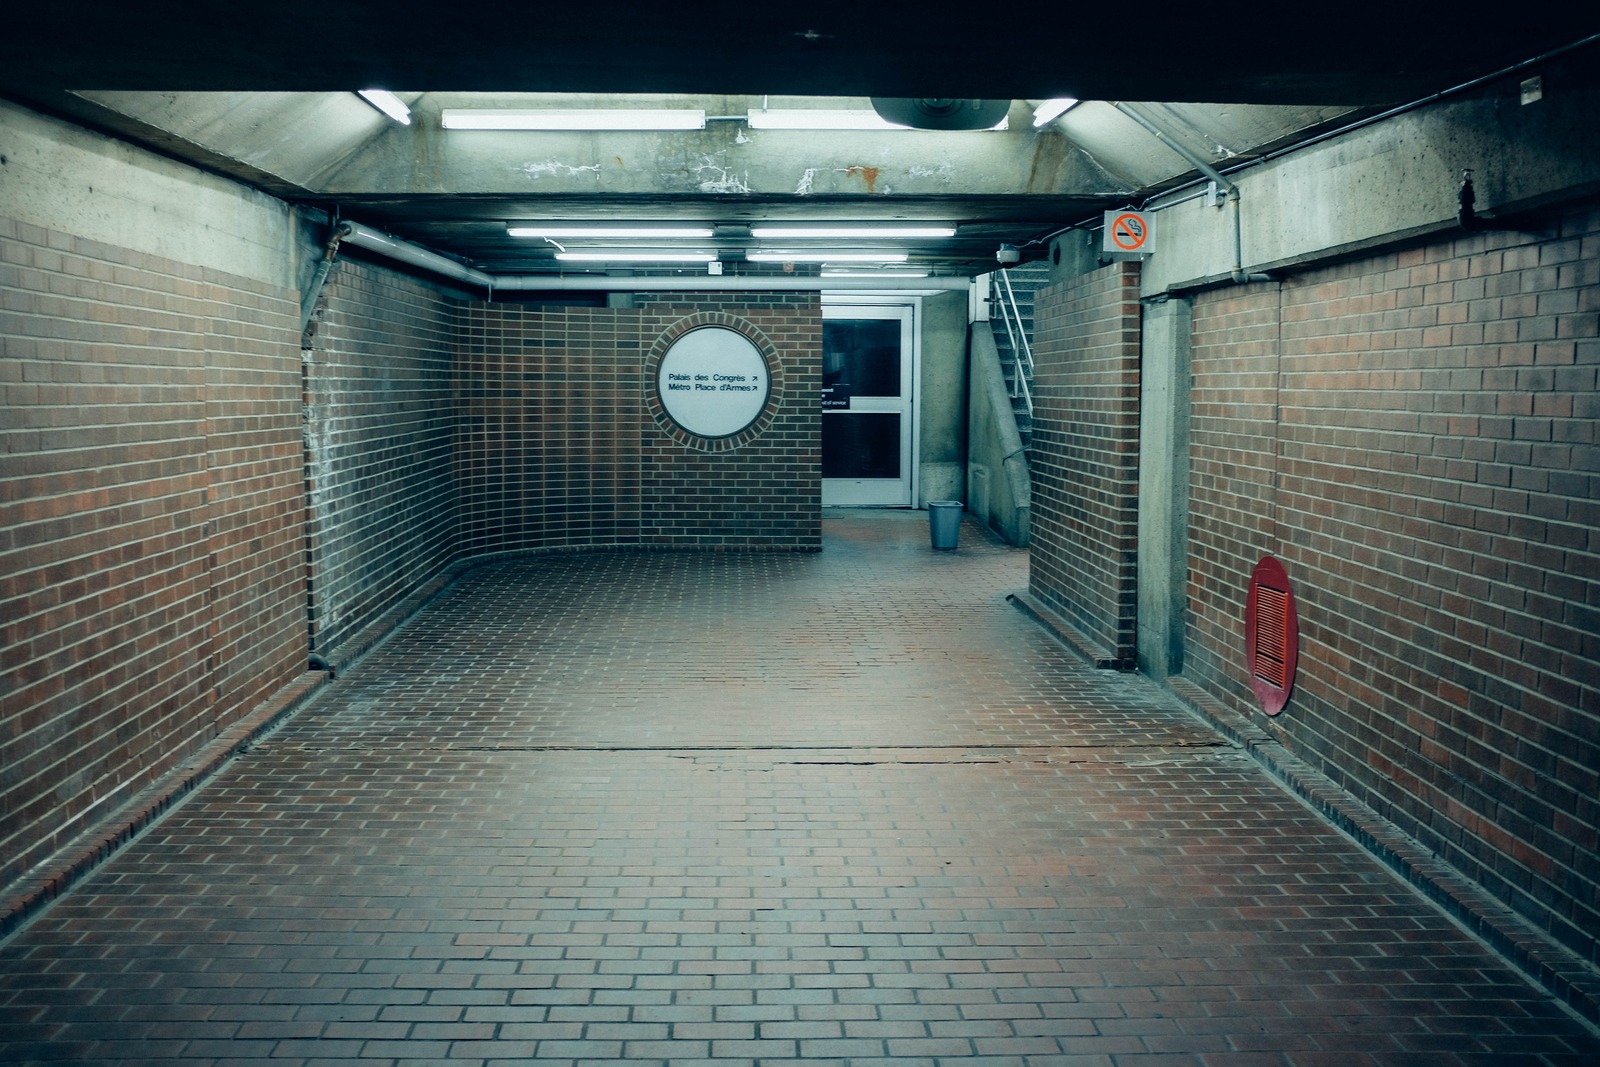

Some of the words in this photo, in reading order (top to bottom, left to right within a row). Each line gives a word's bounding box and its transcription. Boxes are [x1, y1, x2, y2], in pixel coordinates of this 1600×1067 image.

[668, 373, 691, 381] Palais
[694, 373, 709, 381] des
[712, 373, 746, 383] Congrès
[668, 383, 691, 391] Métro
[695, 383, 716, 391] Place
